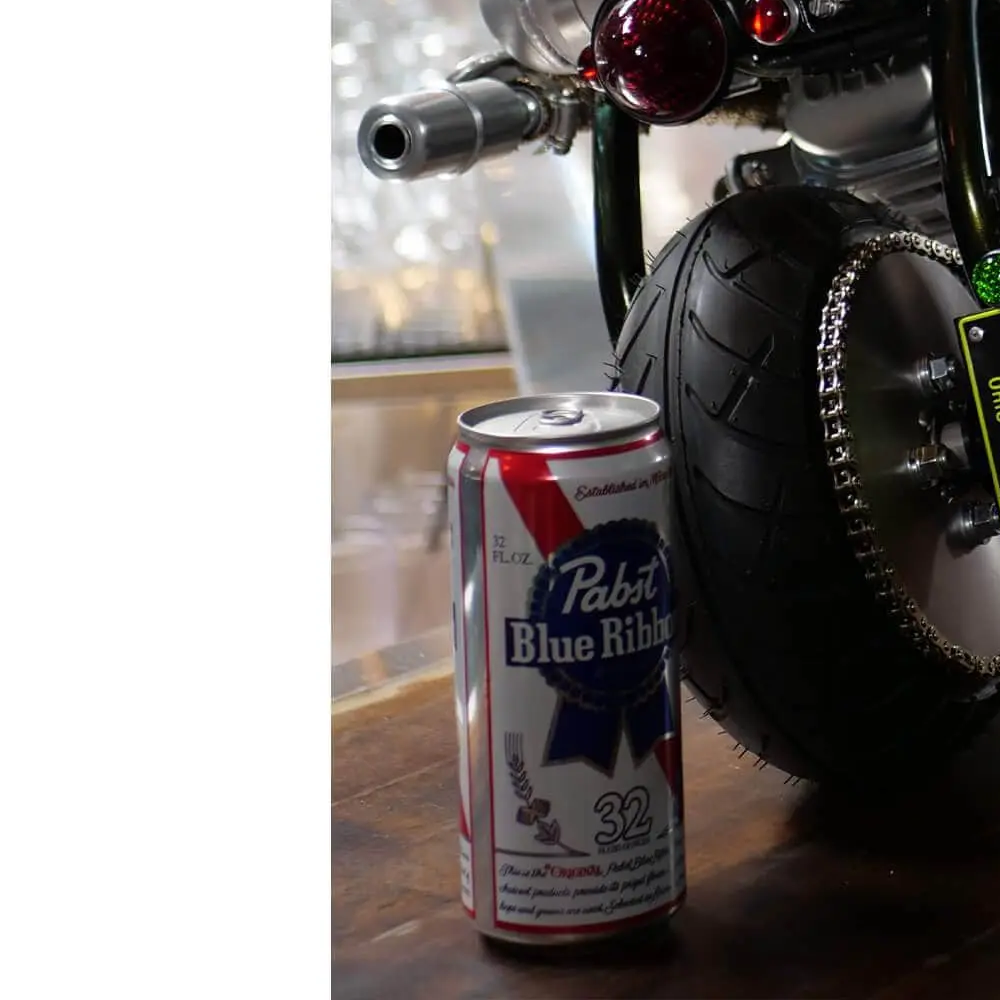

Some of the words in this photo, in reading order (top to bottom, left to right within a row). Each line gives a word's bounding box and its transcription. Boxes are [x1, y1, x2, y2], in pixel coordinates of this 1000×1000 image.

[574, 478, 637, 502] Established
[559, 553, 660, 615] Pabst
[510, 620, 595, 664] Blue
[593, 785, 654, 846] 32
